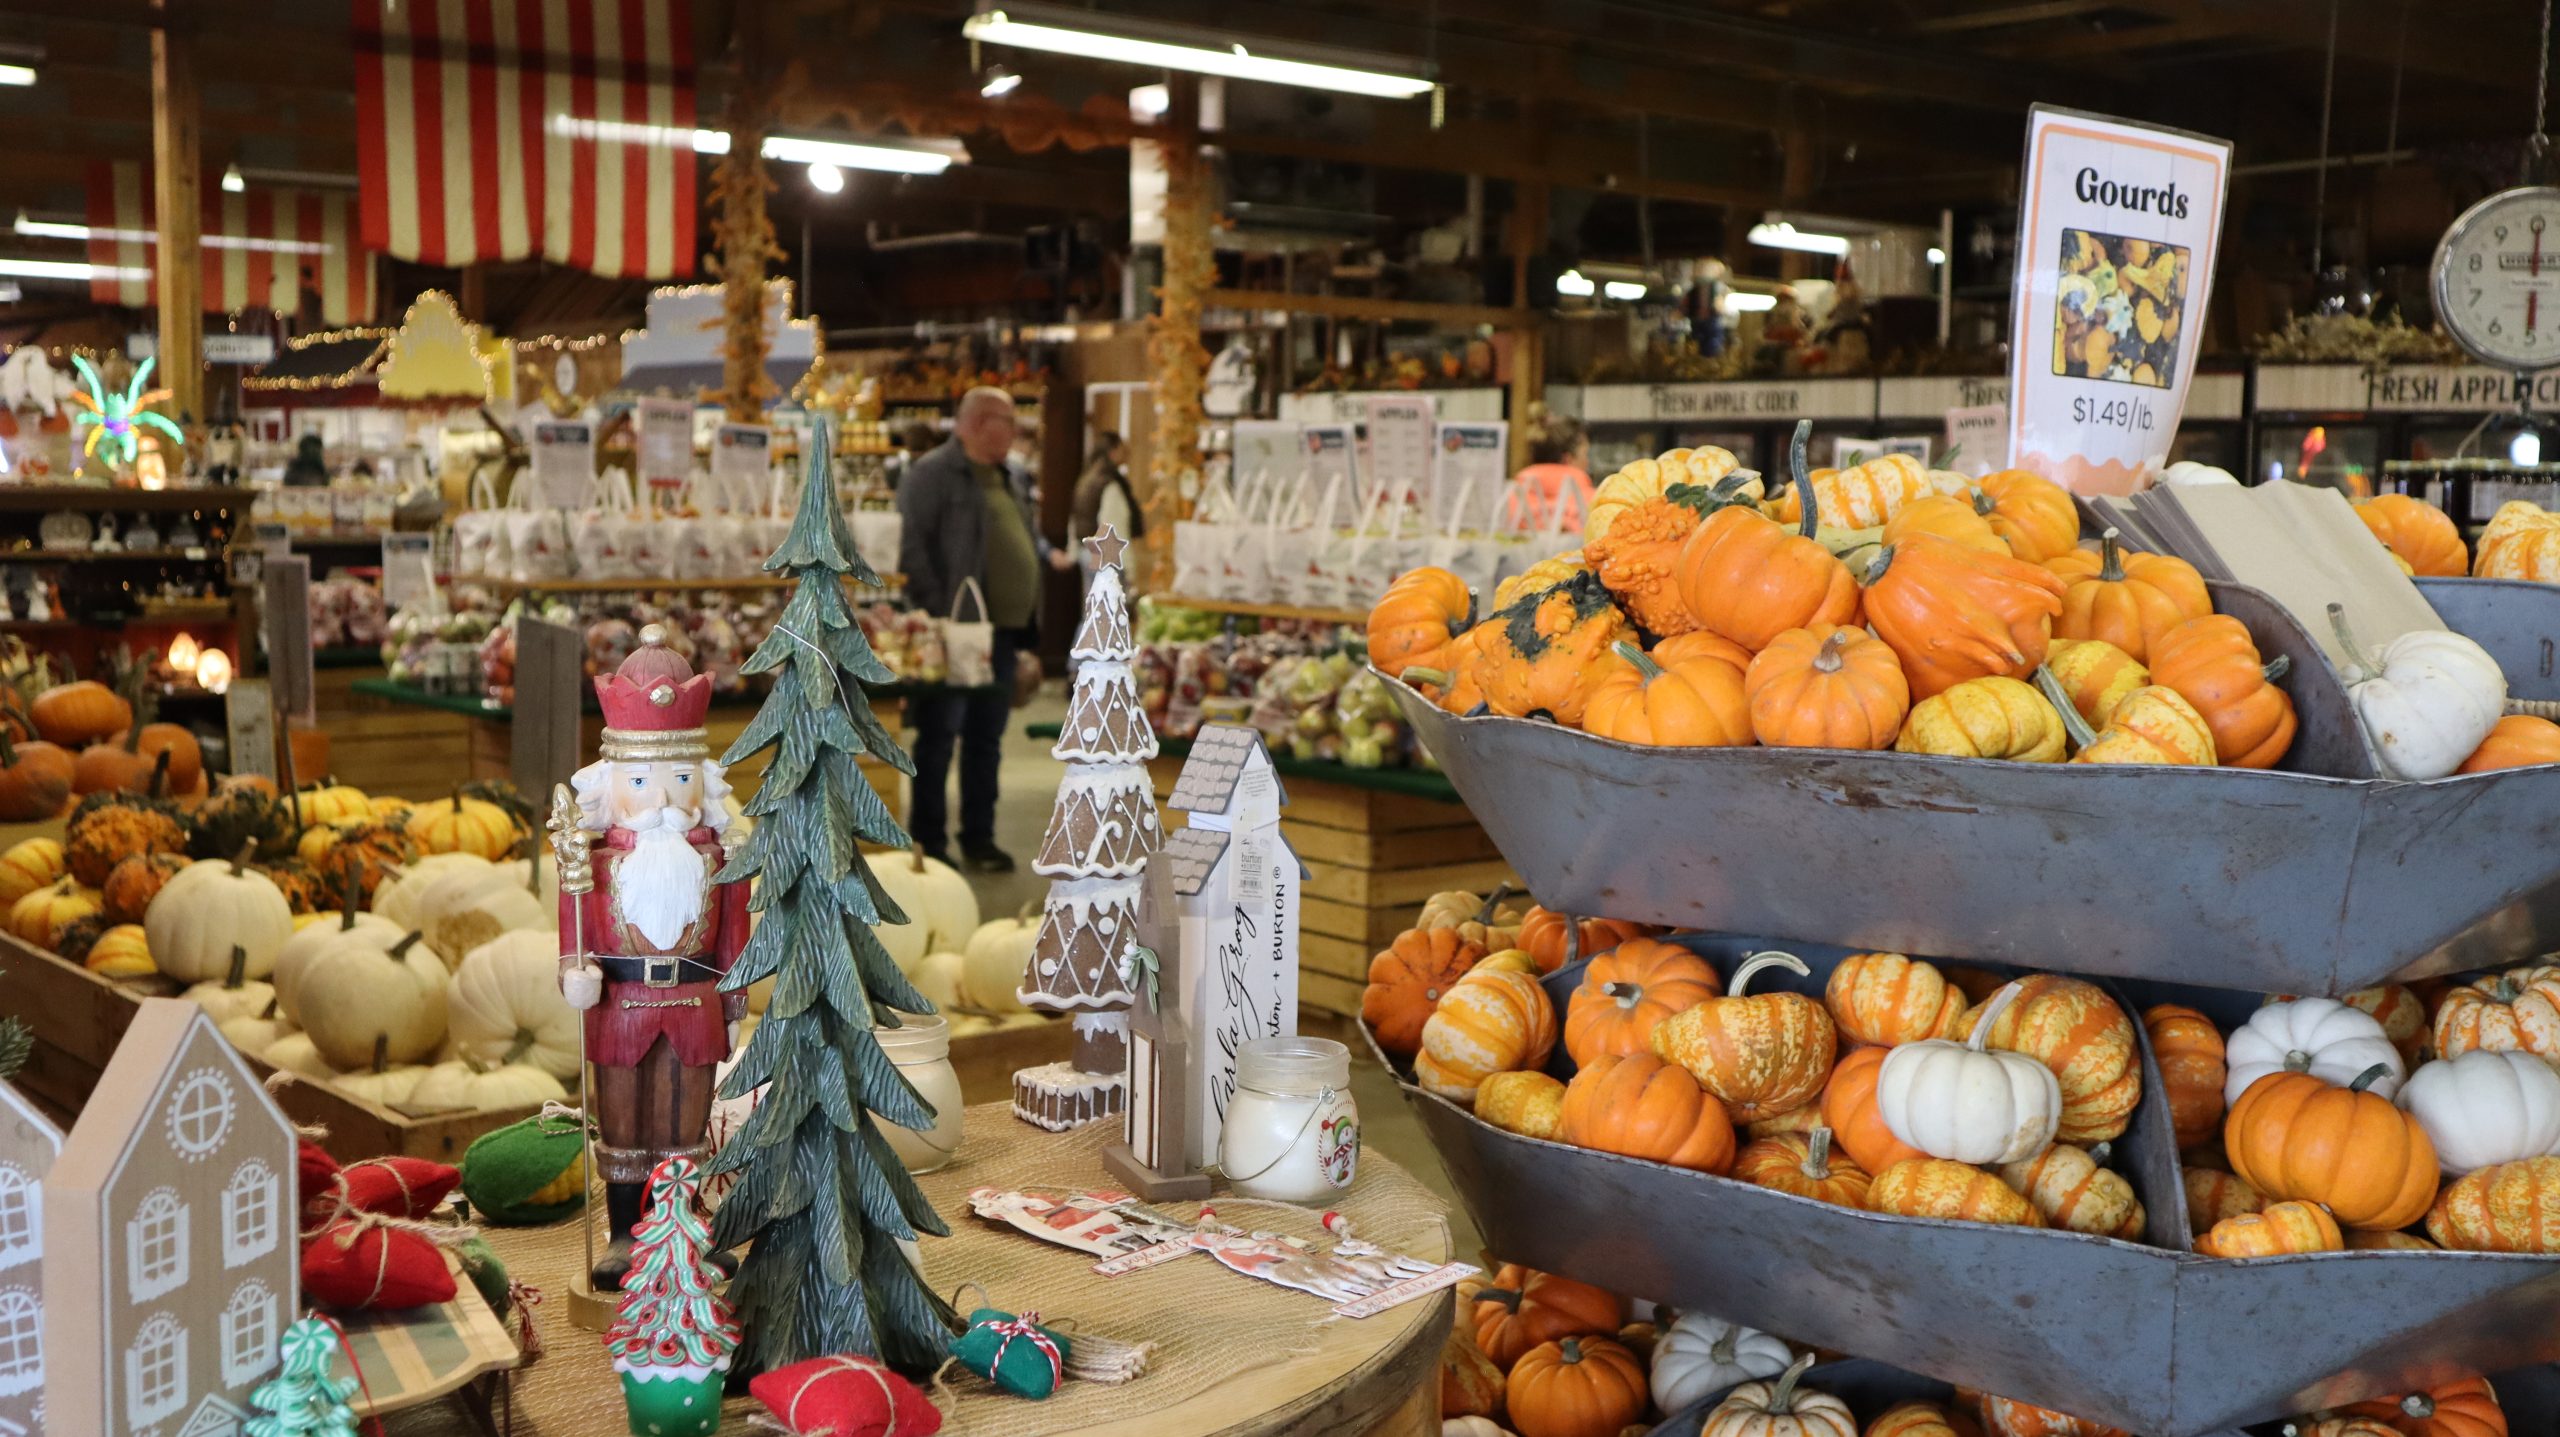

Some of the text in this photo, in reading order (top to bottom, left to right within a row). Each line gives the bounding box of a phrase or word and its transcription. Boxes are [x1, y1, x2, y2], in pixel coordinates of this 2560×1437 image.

[2075, 167, 2189, 220] Gourds
[2494, 225, 2508, 244] 9
[2469, 253, 2482, 273] 8
[2469, 288, 2482, 308] 7
[2488, 316, 2502, 336] 6
[1651, 384, 1799, 418] FRESH APPLE CIDER
[1957, 377, 2007, 408] FRES
[2361, 371, 2560, 409] FRESH APPL CI
[2073, 396, 2155, 433] $1.49/lb.
[1220, 901, 1261, 1041] Grog
[1267, 986, 1282, 1037] rton
